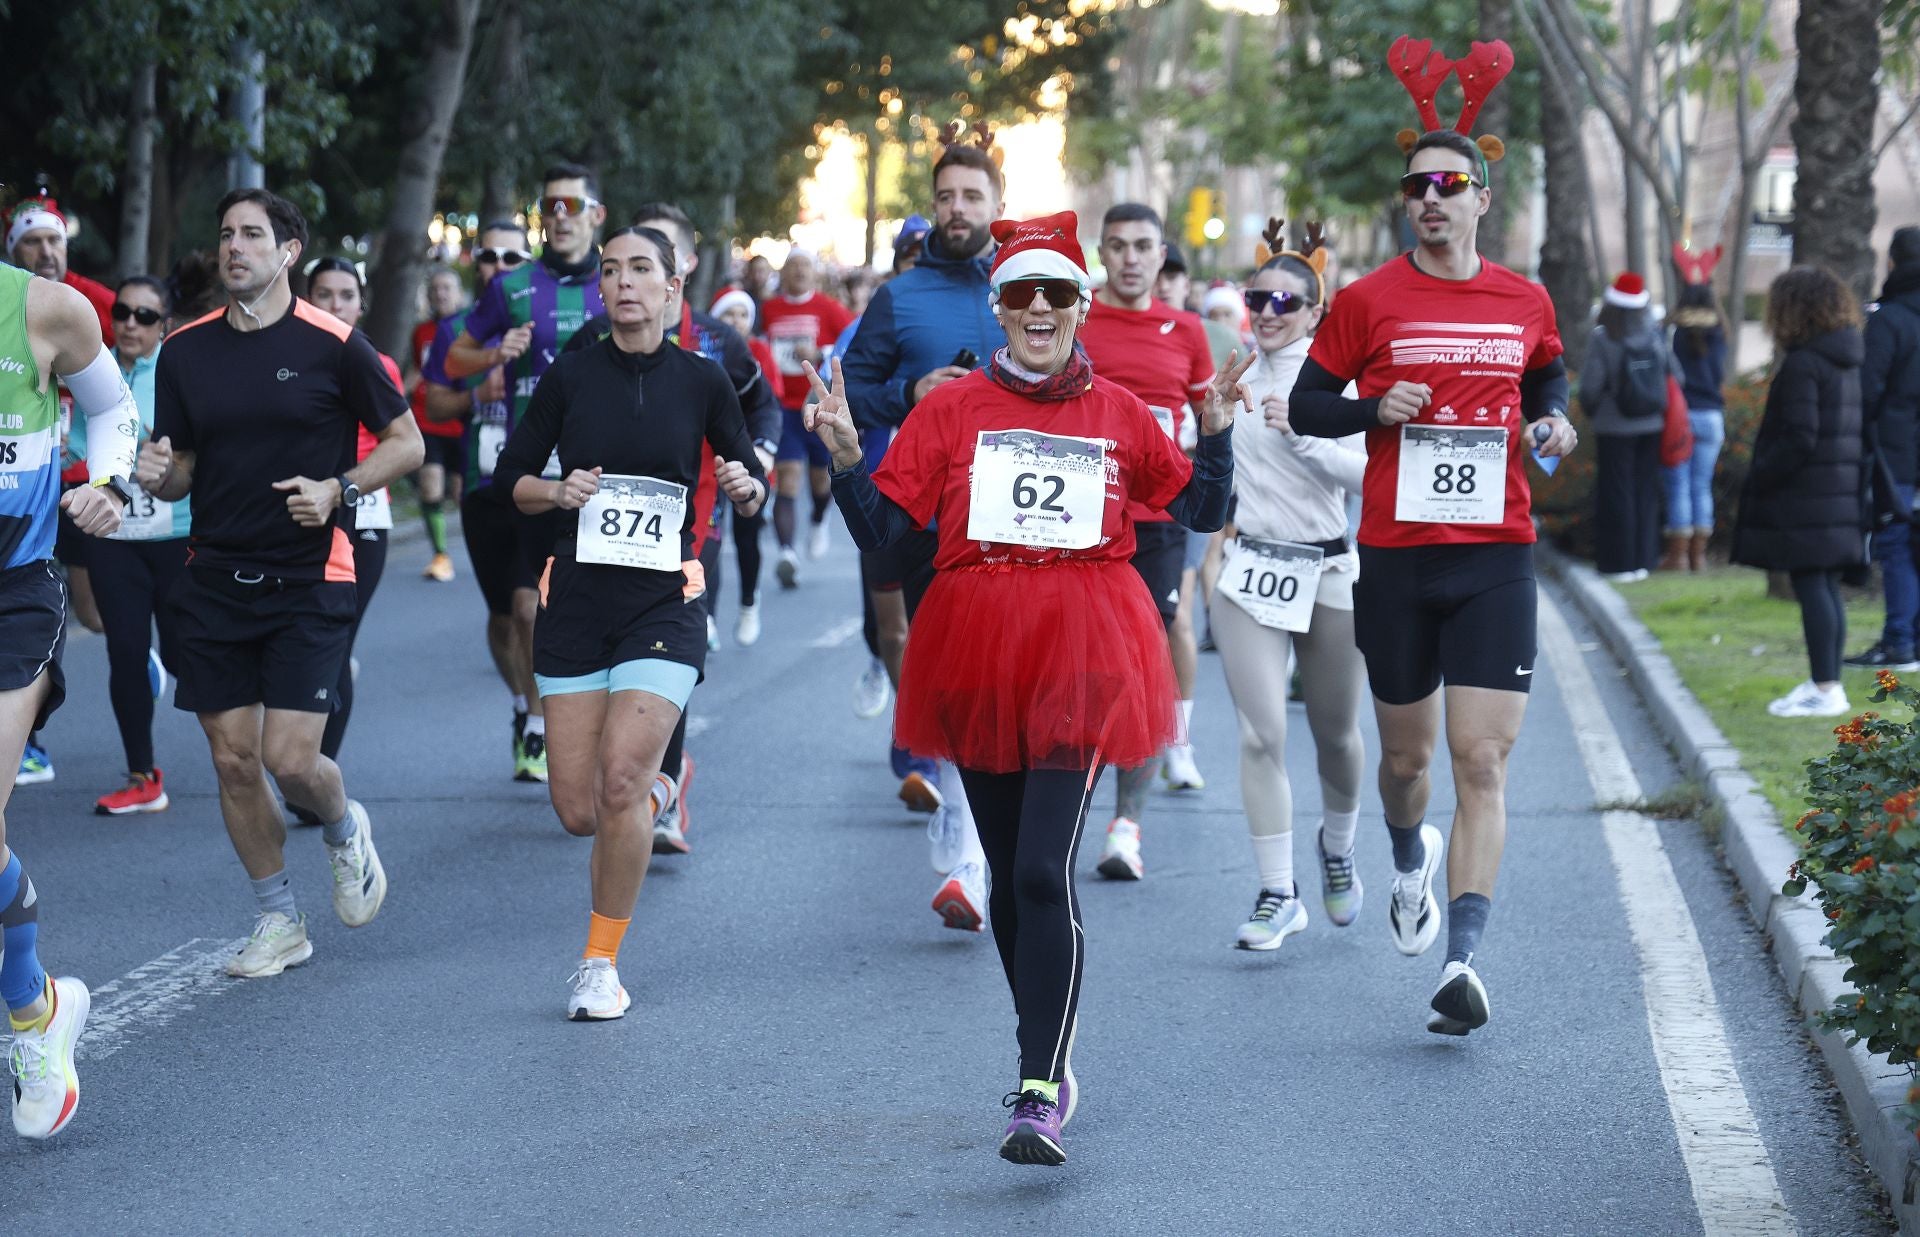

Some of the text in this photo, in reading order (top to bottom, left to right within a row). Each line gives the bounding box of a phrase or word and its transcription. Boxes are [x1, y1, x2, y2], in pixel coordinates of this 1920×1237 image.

[1458, 346, 1478, 354] SAN
[1478, 338, 1524, 350] CARRERA
[1430, 353, 1524, 367] PALMA PALMILLA
[1012, 472, 1066, 513] 62
[1432, 463, 1477, 494] 88
[600, 508, 663, 543] 874
[1238, 567, 1299, 602] 100
